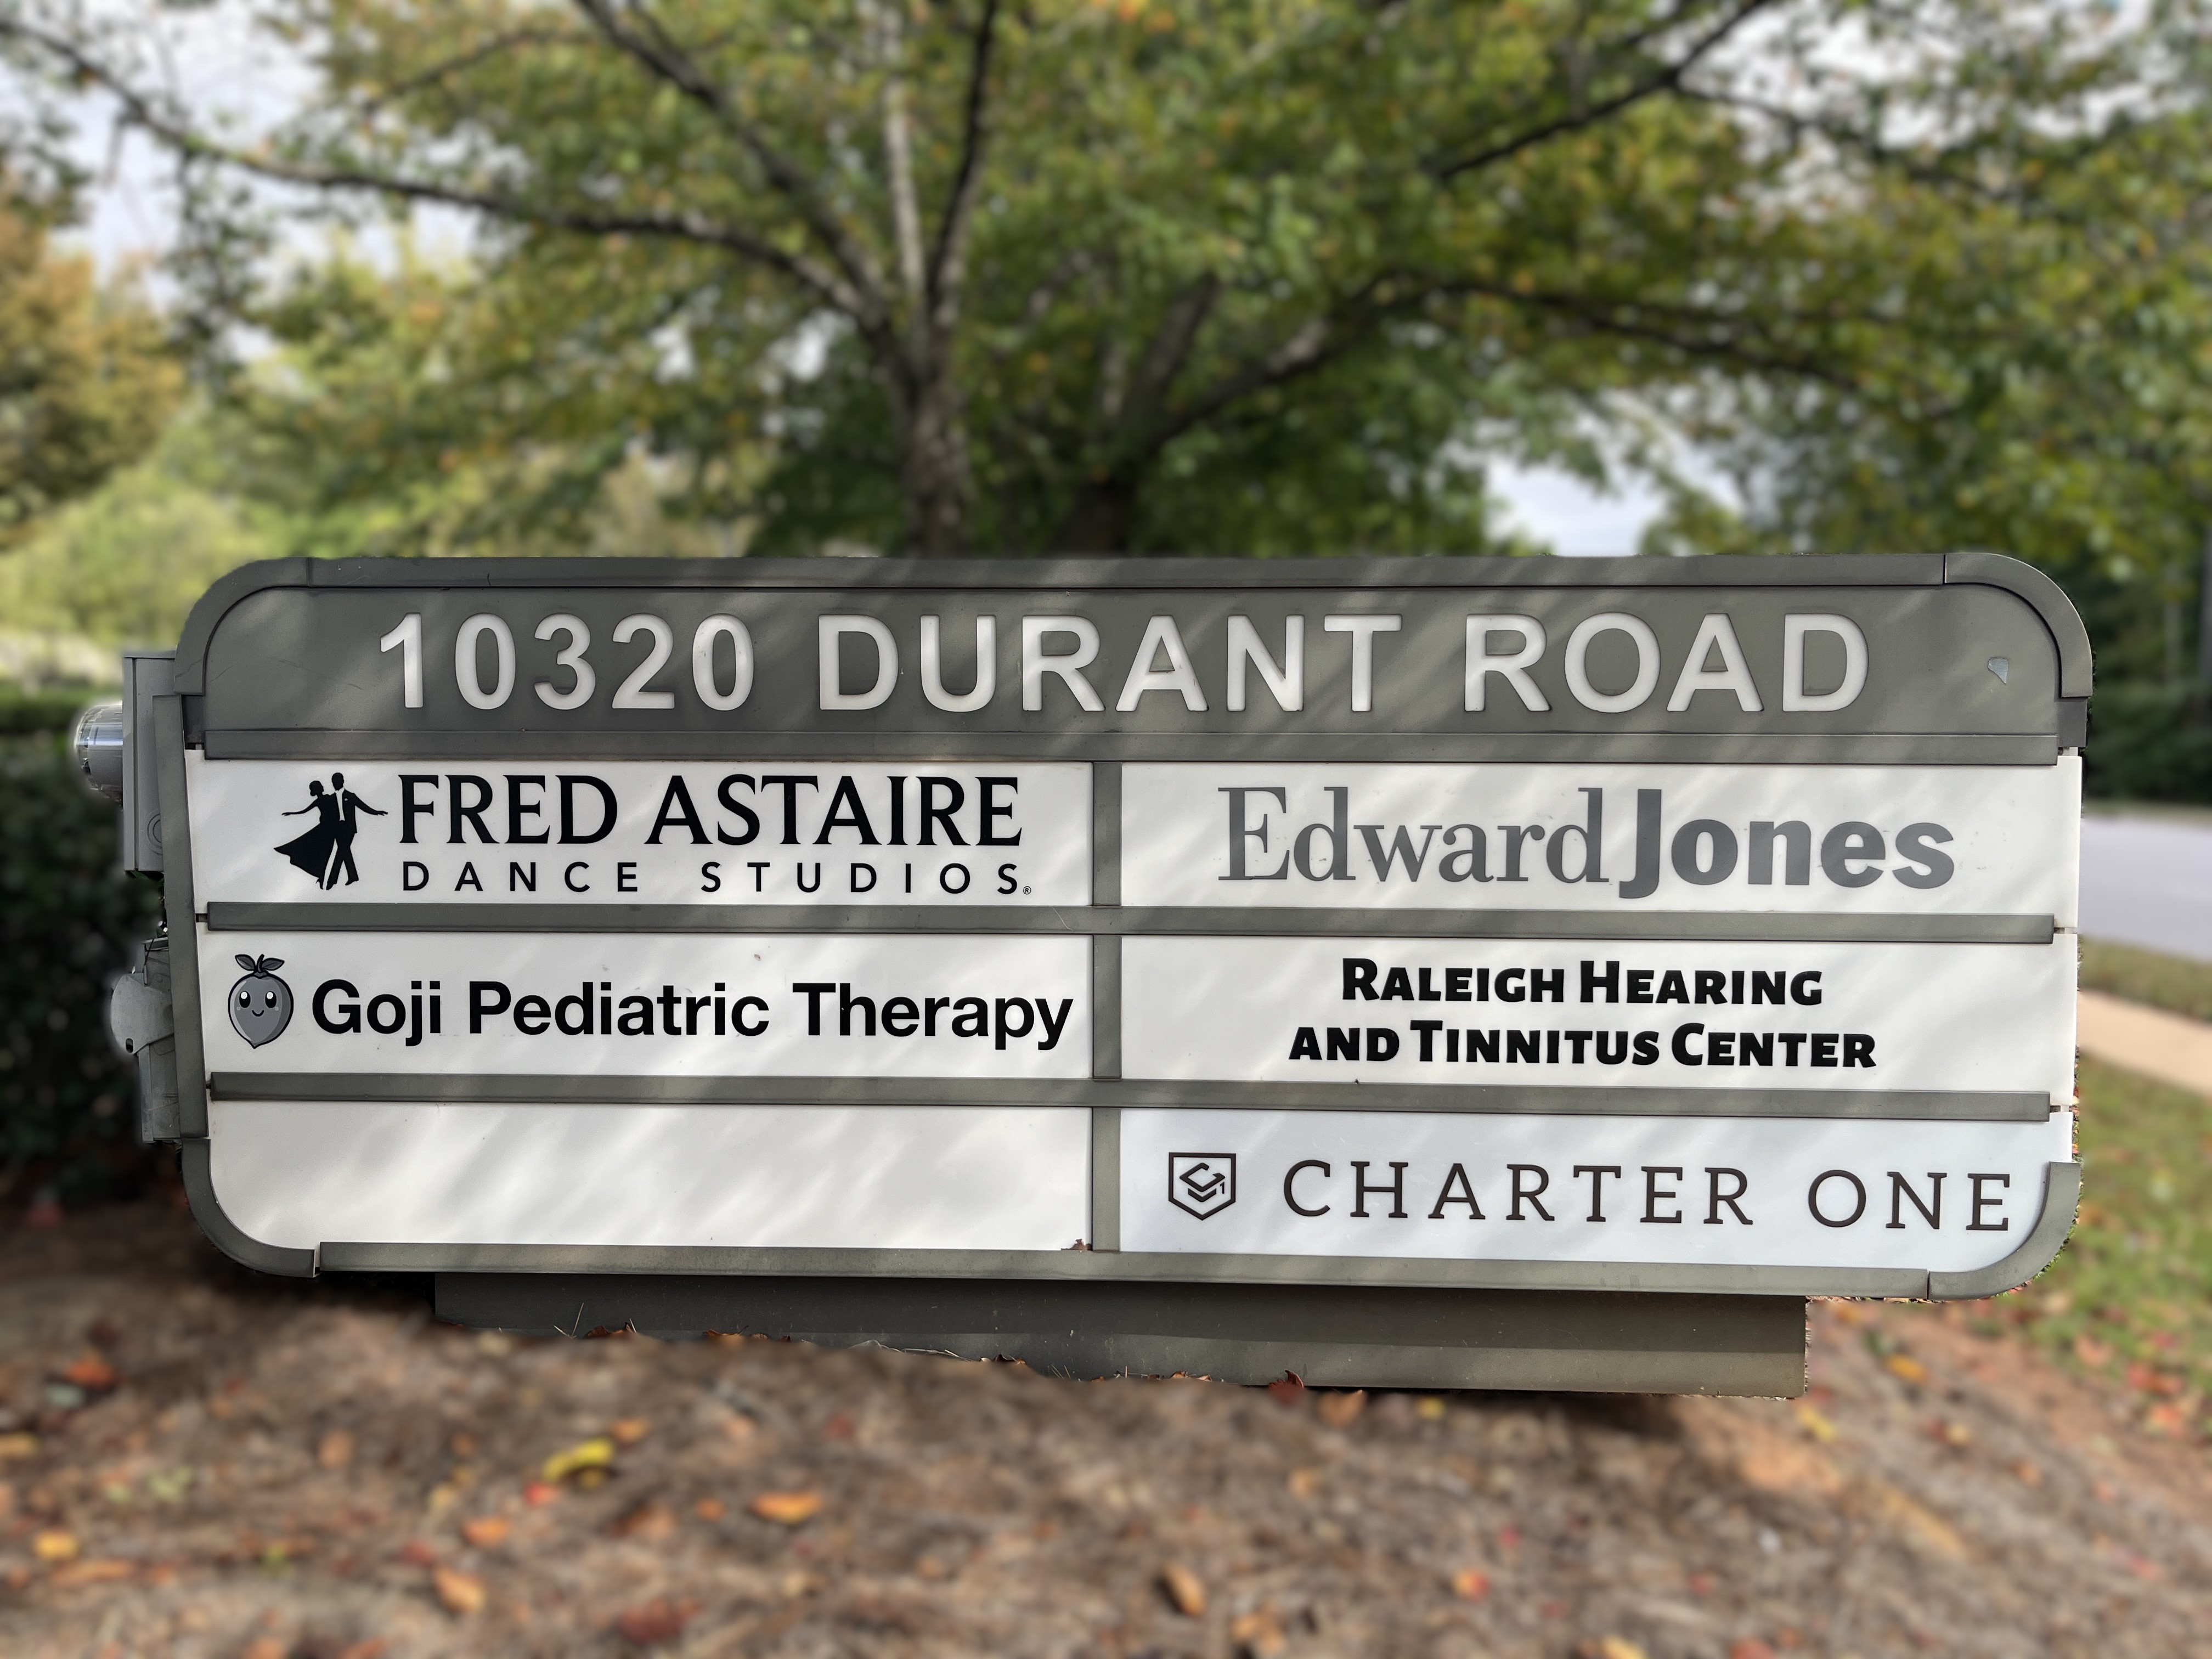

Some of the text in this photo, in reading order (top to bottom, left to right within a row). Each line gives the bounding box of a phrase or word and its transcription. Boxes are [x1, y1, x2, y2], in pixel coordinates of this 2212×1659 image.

[380, 611, 1869, 713] 10320 DURANT ROAD
[398, 774, 1022, 847] FRED ASTAIRE
[403, 861, 639, 893] DANCE
[312, 979, 1074, 1051] Goji Pediatric Therapy
[1342, 958, 1822, 1006] RALEIGH HEARING
[1288, 1019, 1876, 1068] AND TINNITUS CENTER
[1283, 1159, 2010, 1231] CHARTER ONE
